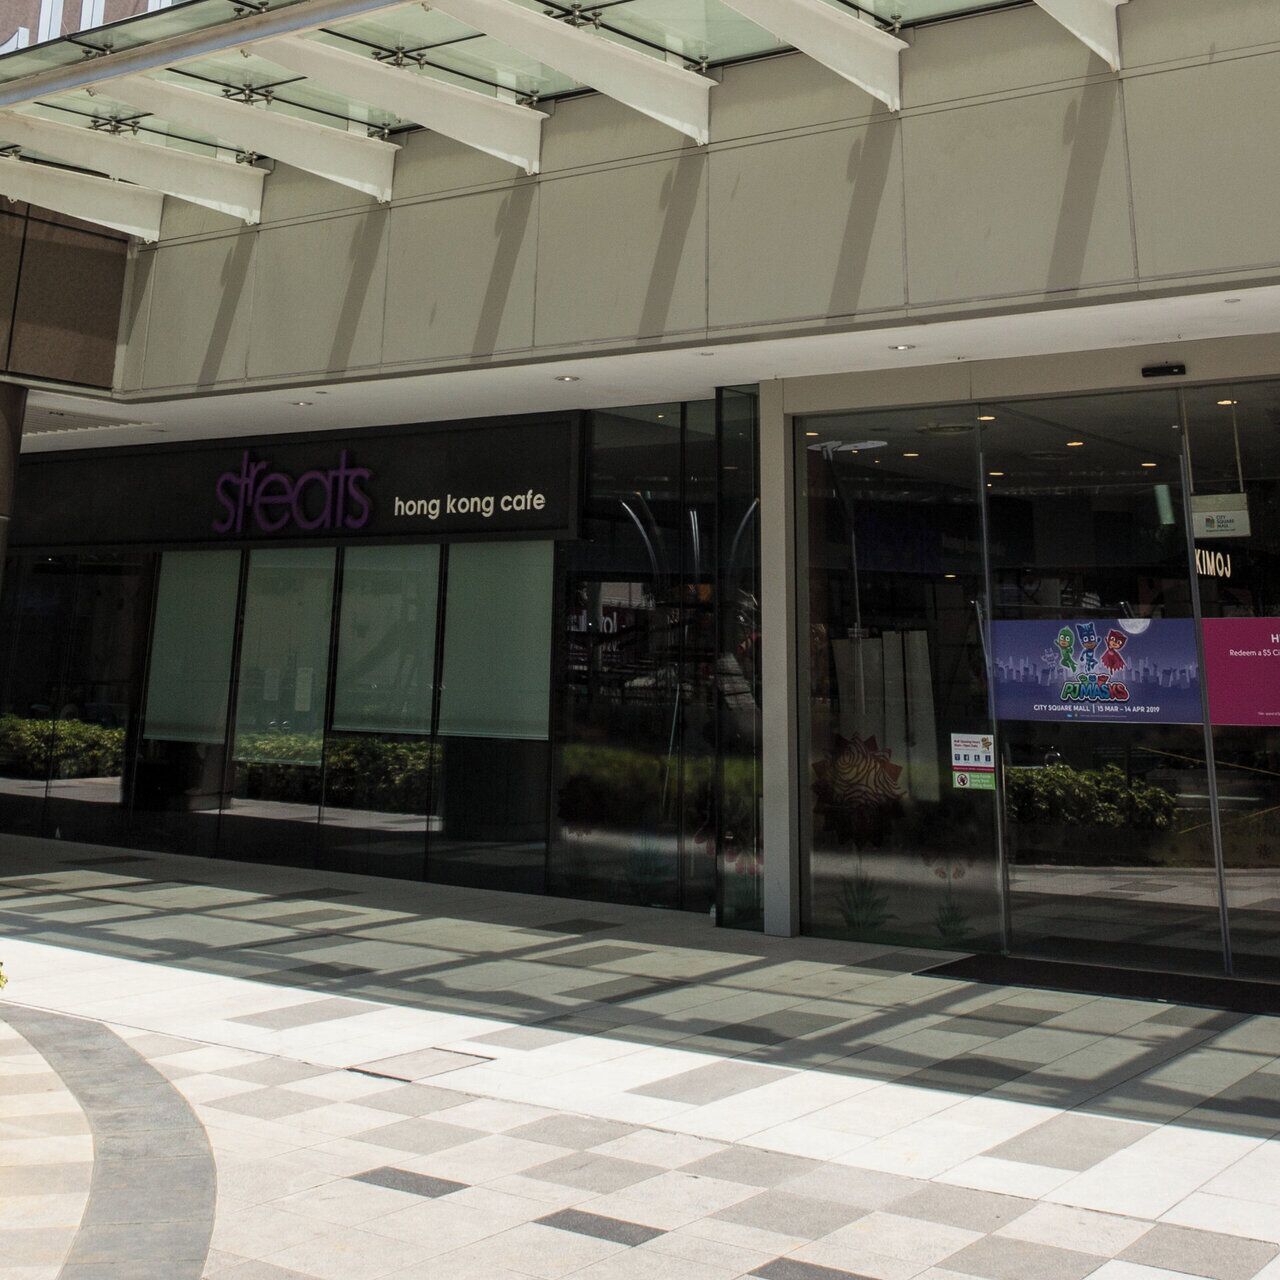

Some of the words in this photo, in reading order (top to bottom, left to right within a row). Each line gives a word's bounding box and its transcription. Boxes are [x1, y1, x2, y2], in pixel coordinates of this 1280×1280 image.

[212, 448, 375, 534] streats
[394, 496, 441, 520] hong
[446, 494, 495, 518] kong
[501, 489, 547, 512] cafe
[1195, 548, 1231, 578] KIMOJ
[1229, 648, 1257, 657] Redeem
[1262, 648, 1271, 657] $5
[1033, 704, 1047, 712] CITY
[1048, 704, 1073, 712] SQUARE
[1096, 705, 1104, 713] 15
